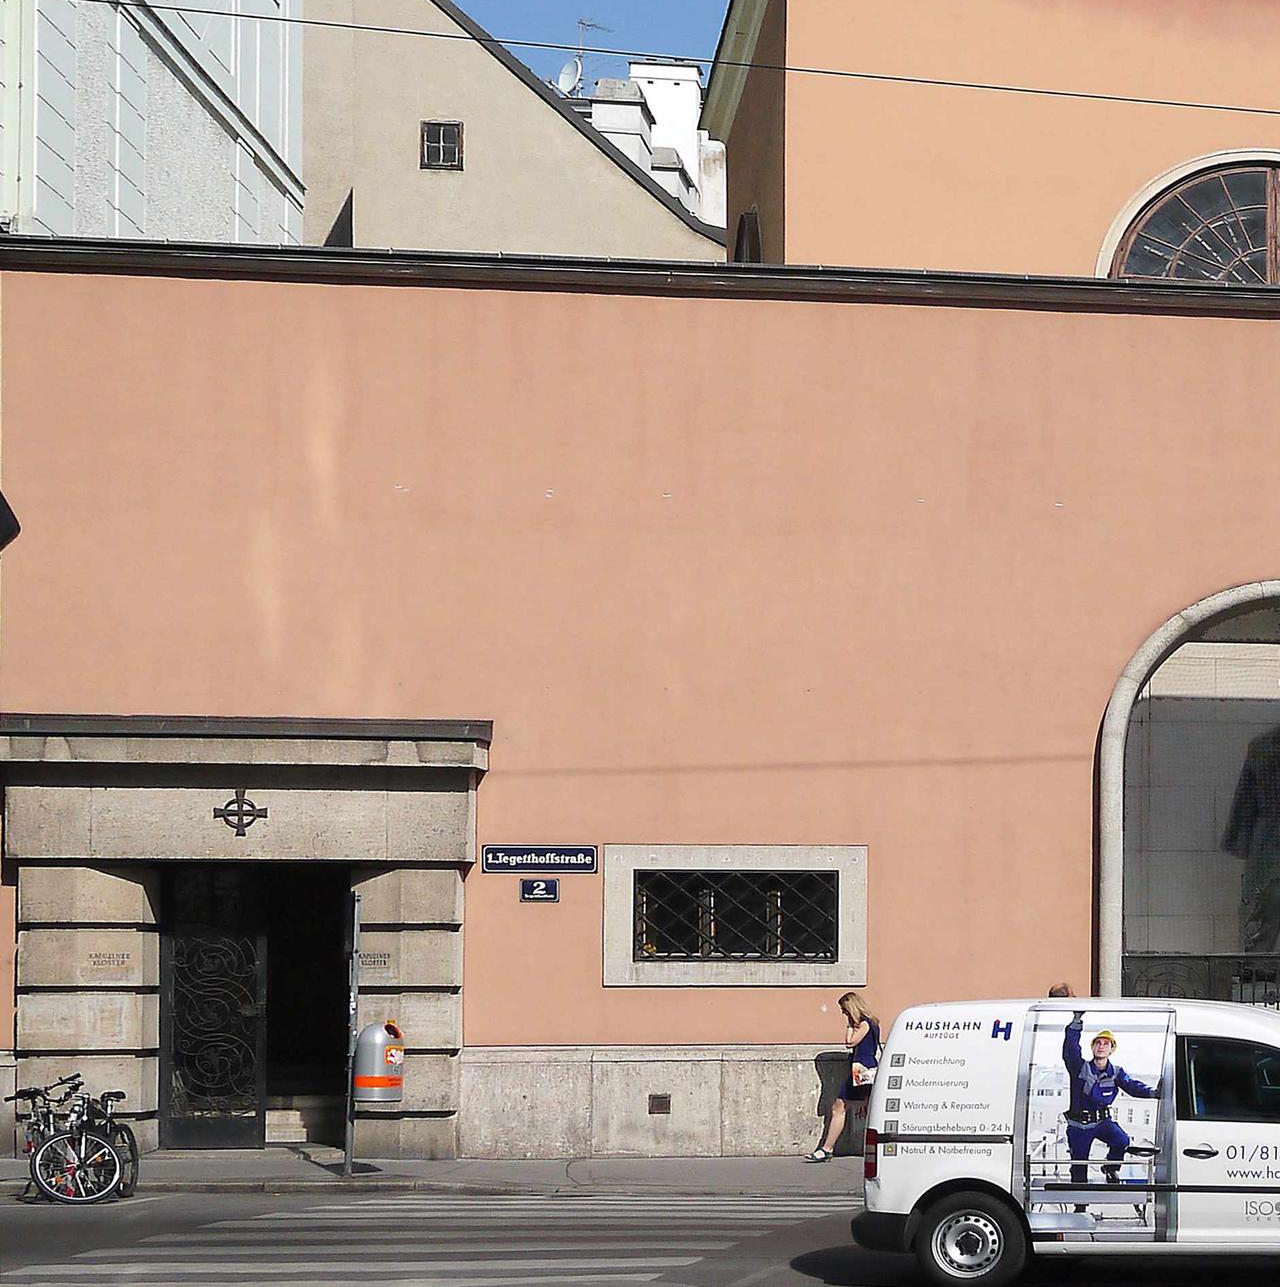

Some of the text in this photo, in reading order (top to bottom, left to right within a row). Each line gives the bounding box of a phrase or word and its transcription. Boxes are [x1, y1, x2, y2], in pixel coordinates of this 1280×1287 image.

[533, 881, 546, 894] 2
[905, 1021, 981, 1030] HAUSHAHN
[908, 1057, 966, 1066] Neuerrichtung
[905, 1079, 969, 1089] Modernisierung
[903, 1102, 939, 1111] Wartung
[941, 1102, 948, 1110] &
[951, 1102, 990, 1112] Reparatur
[902, 1123, 977, 1134] Störungsbehebung
[1004, 1123, 1010, 1132] h
[901, 1146, 992, 1156] Notruf & Notbefreiung
